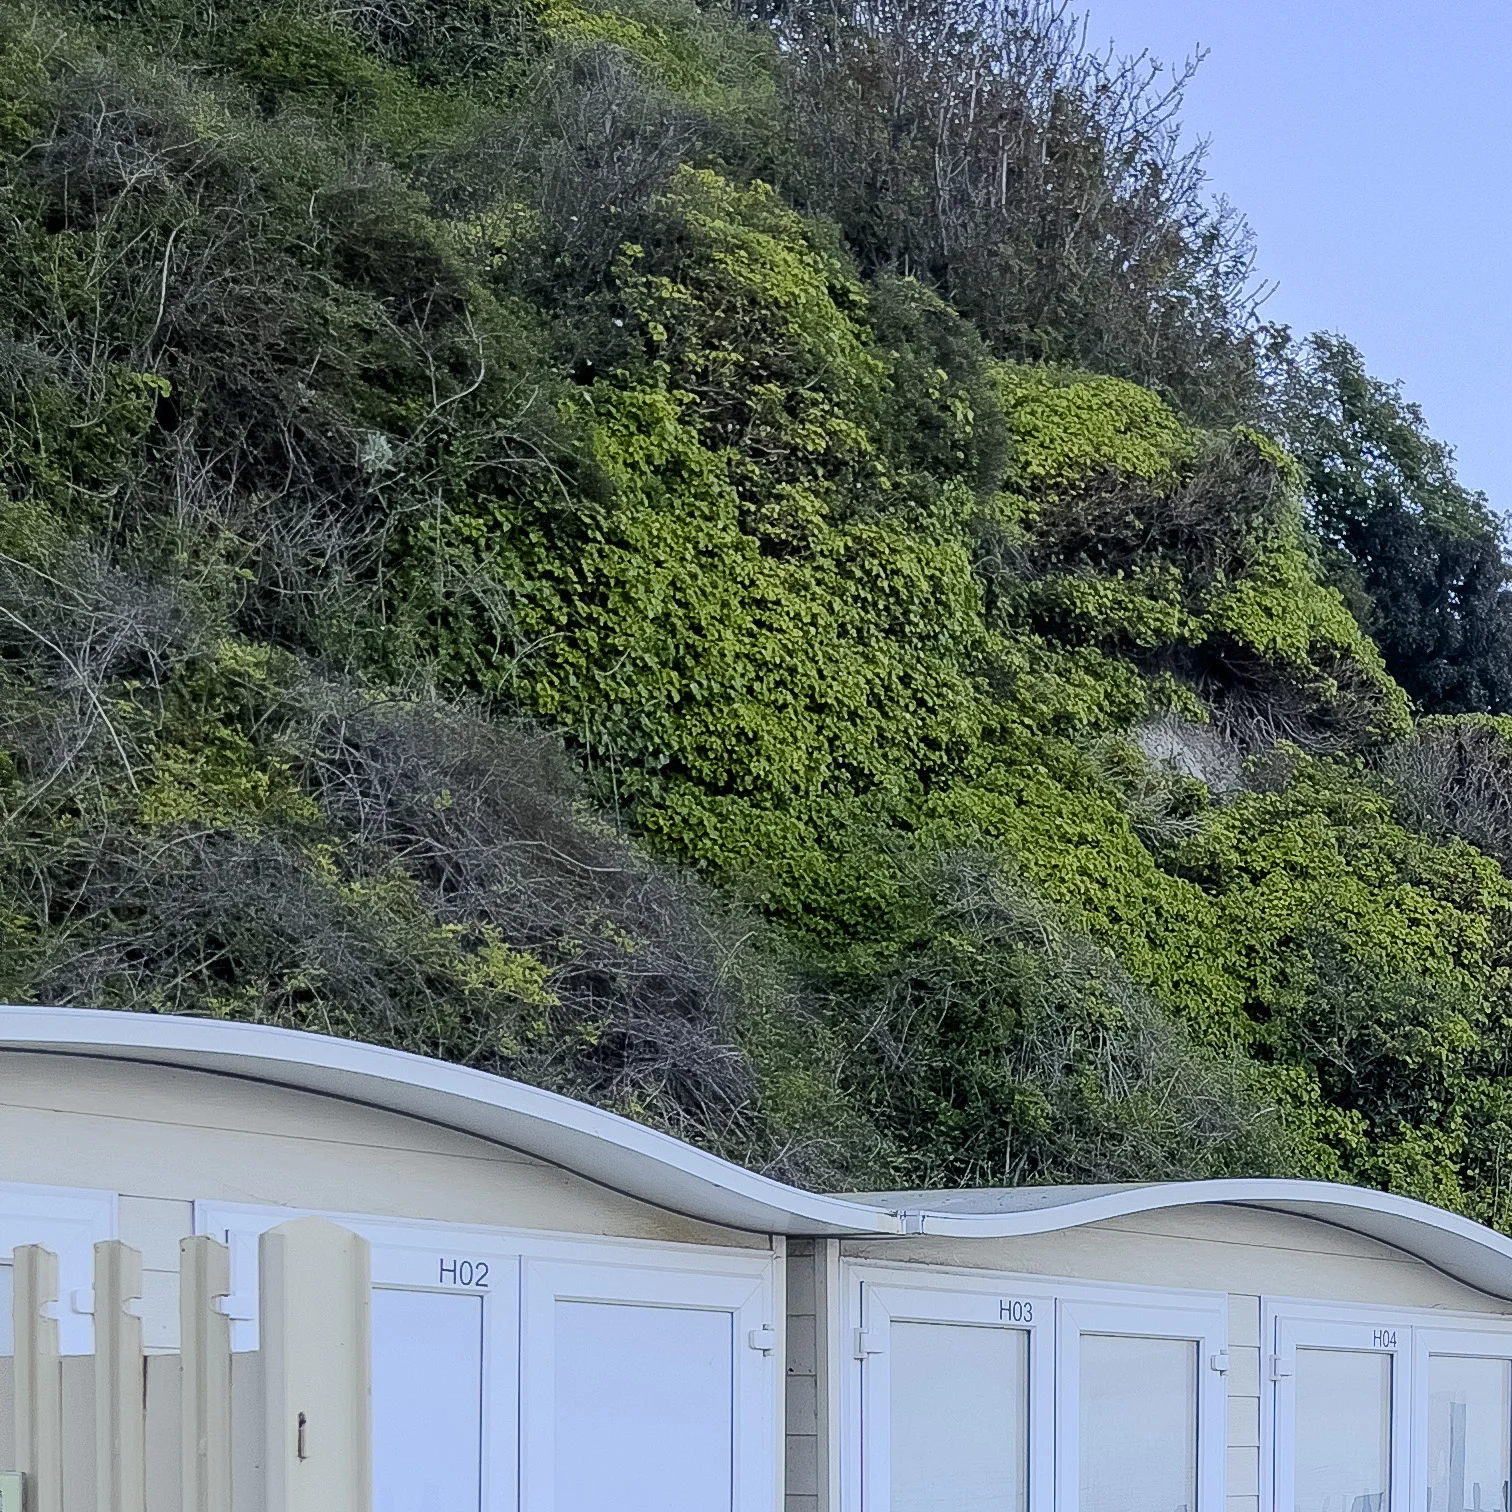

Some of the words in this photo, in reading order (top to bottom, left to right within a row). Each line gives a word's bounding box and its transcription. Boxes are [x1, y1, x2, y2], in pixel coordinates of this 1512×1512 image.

[439, 1257, 489, 1288] H02
[999, 1299, 1033, 1323] H03
[1373, 1329, 1397, 1348] H04
